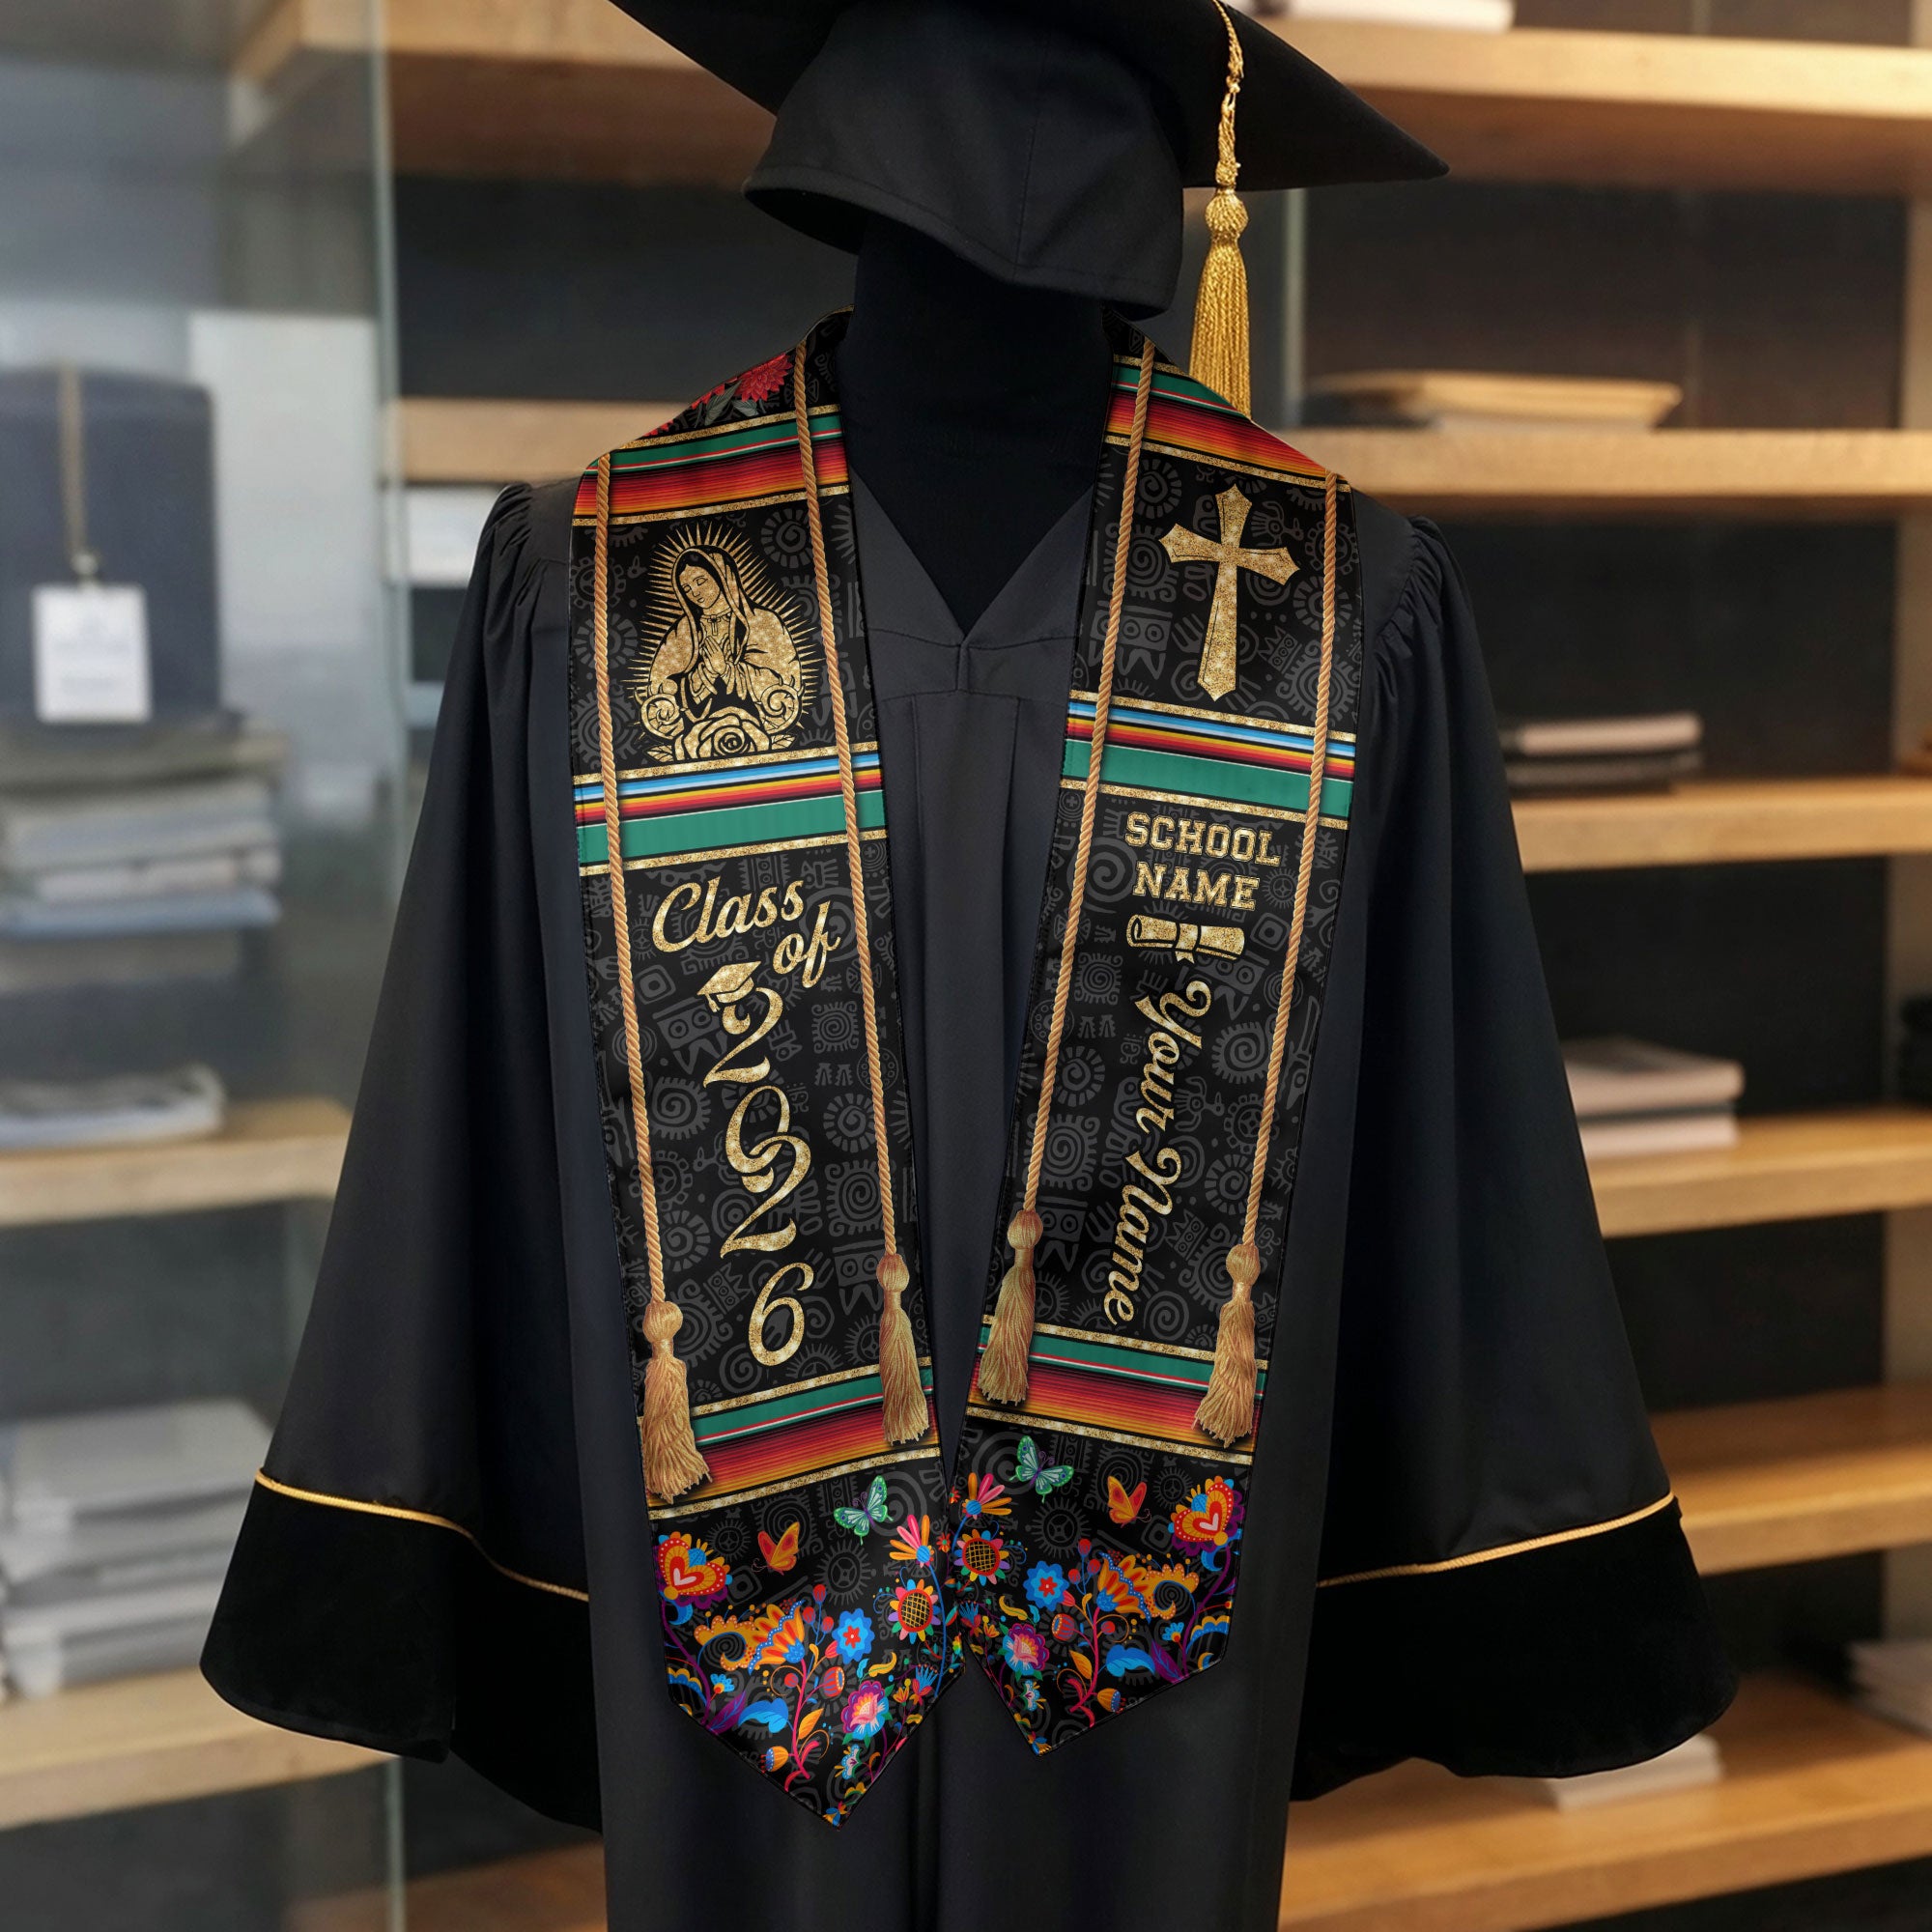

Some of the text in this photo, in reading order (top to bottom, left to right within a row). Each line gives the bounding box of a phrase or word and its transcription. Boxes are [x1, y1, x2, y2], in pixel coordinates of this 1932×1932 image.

[1124, 811, 1282, 867] SCHOOL
[652, 876, 805, 954] Class
[1133, 861, 1261, 912] NAME
[772, 900, 841, 989] of
[702, 986, 814, 1367] 2026
[1103, 980, 1212, 1328] Your Name
